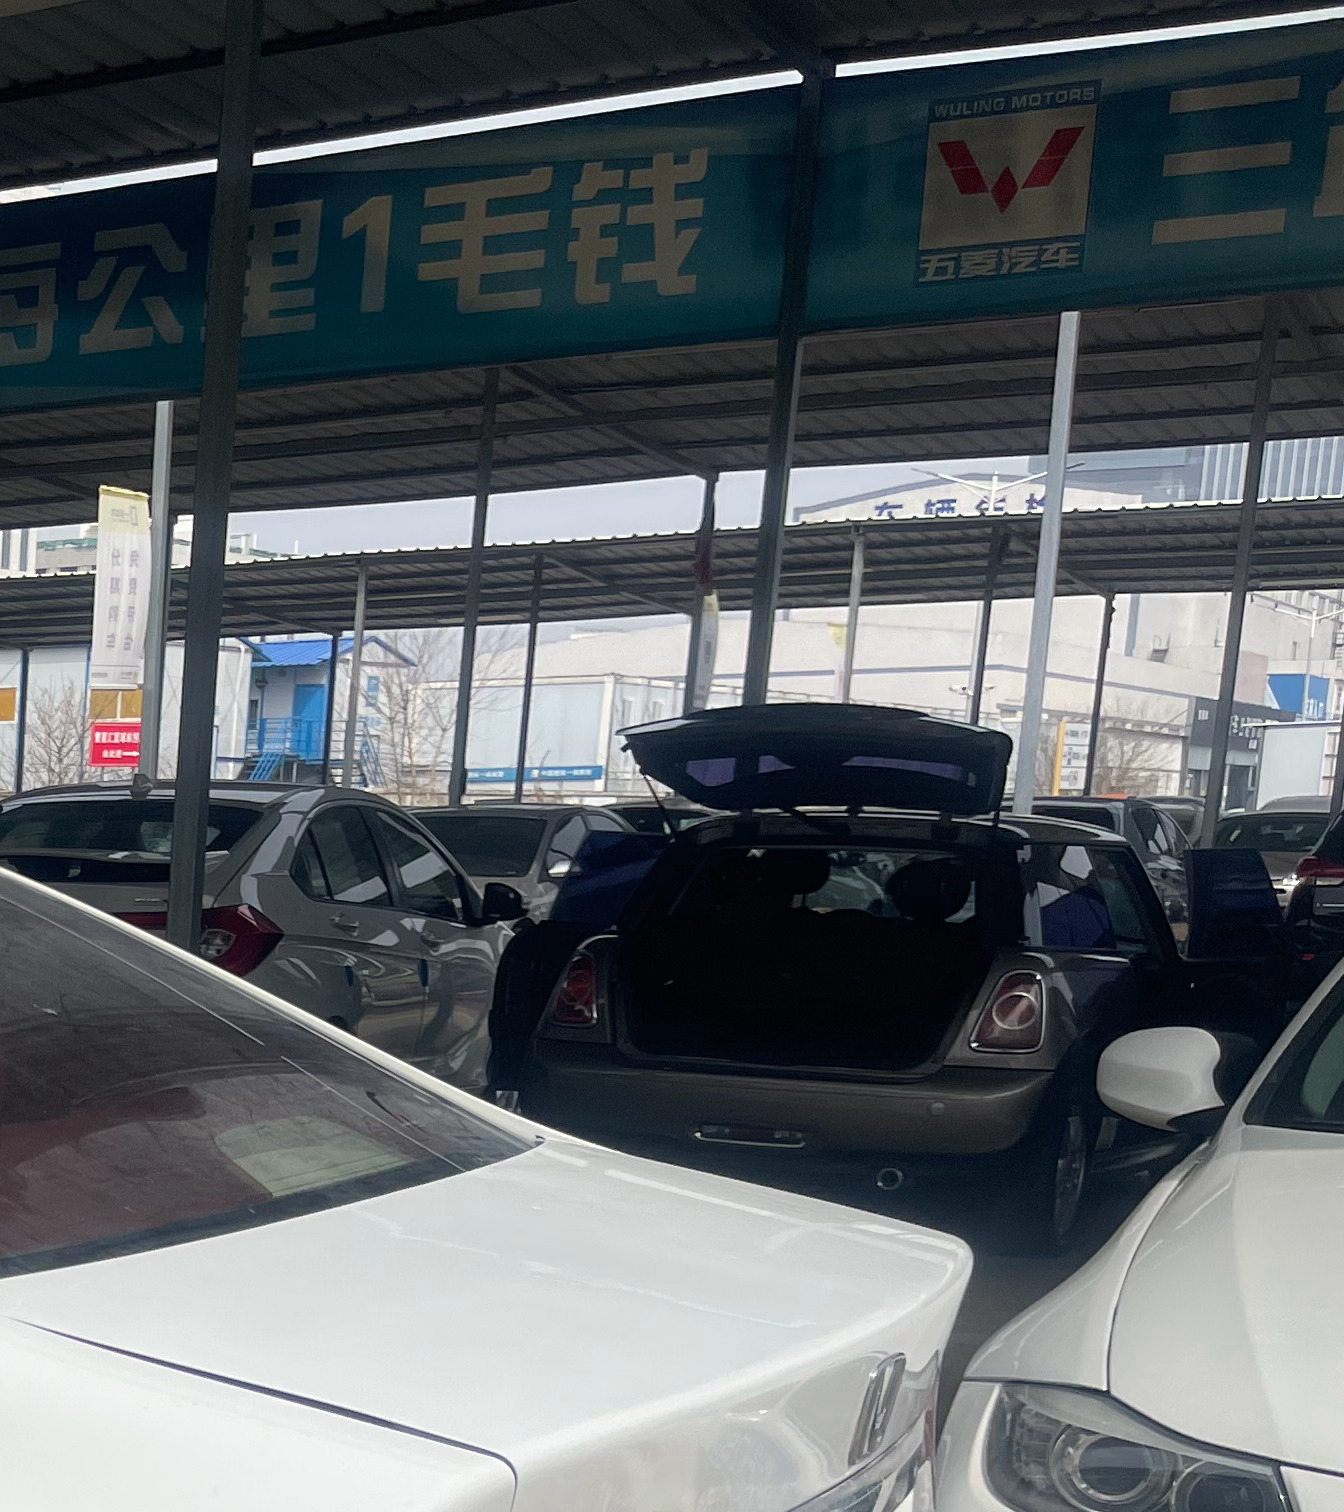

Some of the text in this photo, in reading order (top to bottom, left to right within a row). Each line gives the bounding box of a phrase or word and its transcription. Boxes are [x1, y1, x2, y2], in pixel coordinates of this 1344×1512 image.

[933, 87, 1096, 118] WULING MOTORS
[918, 242, 1081, 284] 五菱汽车
